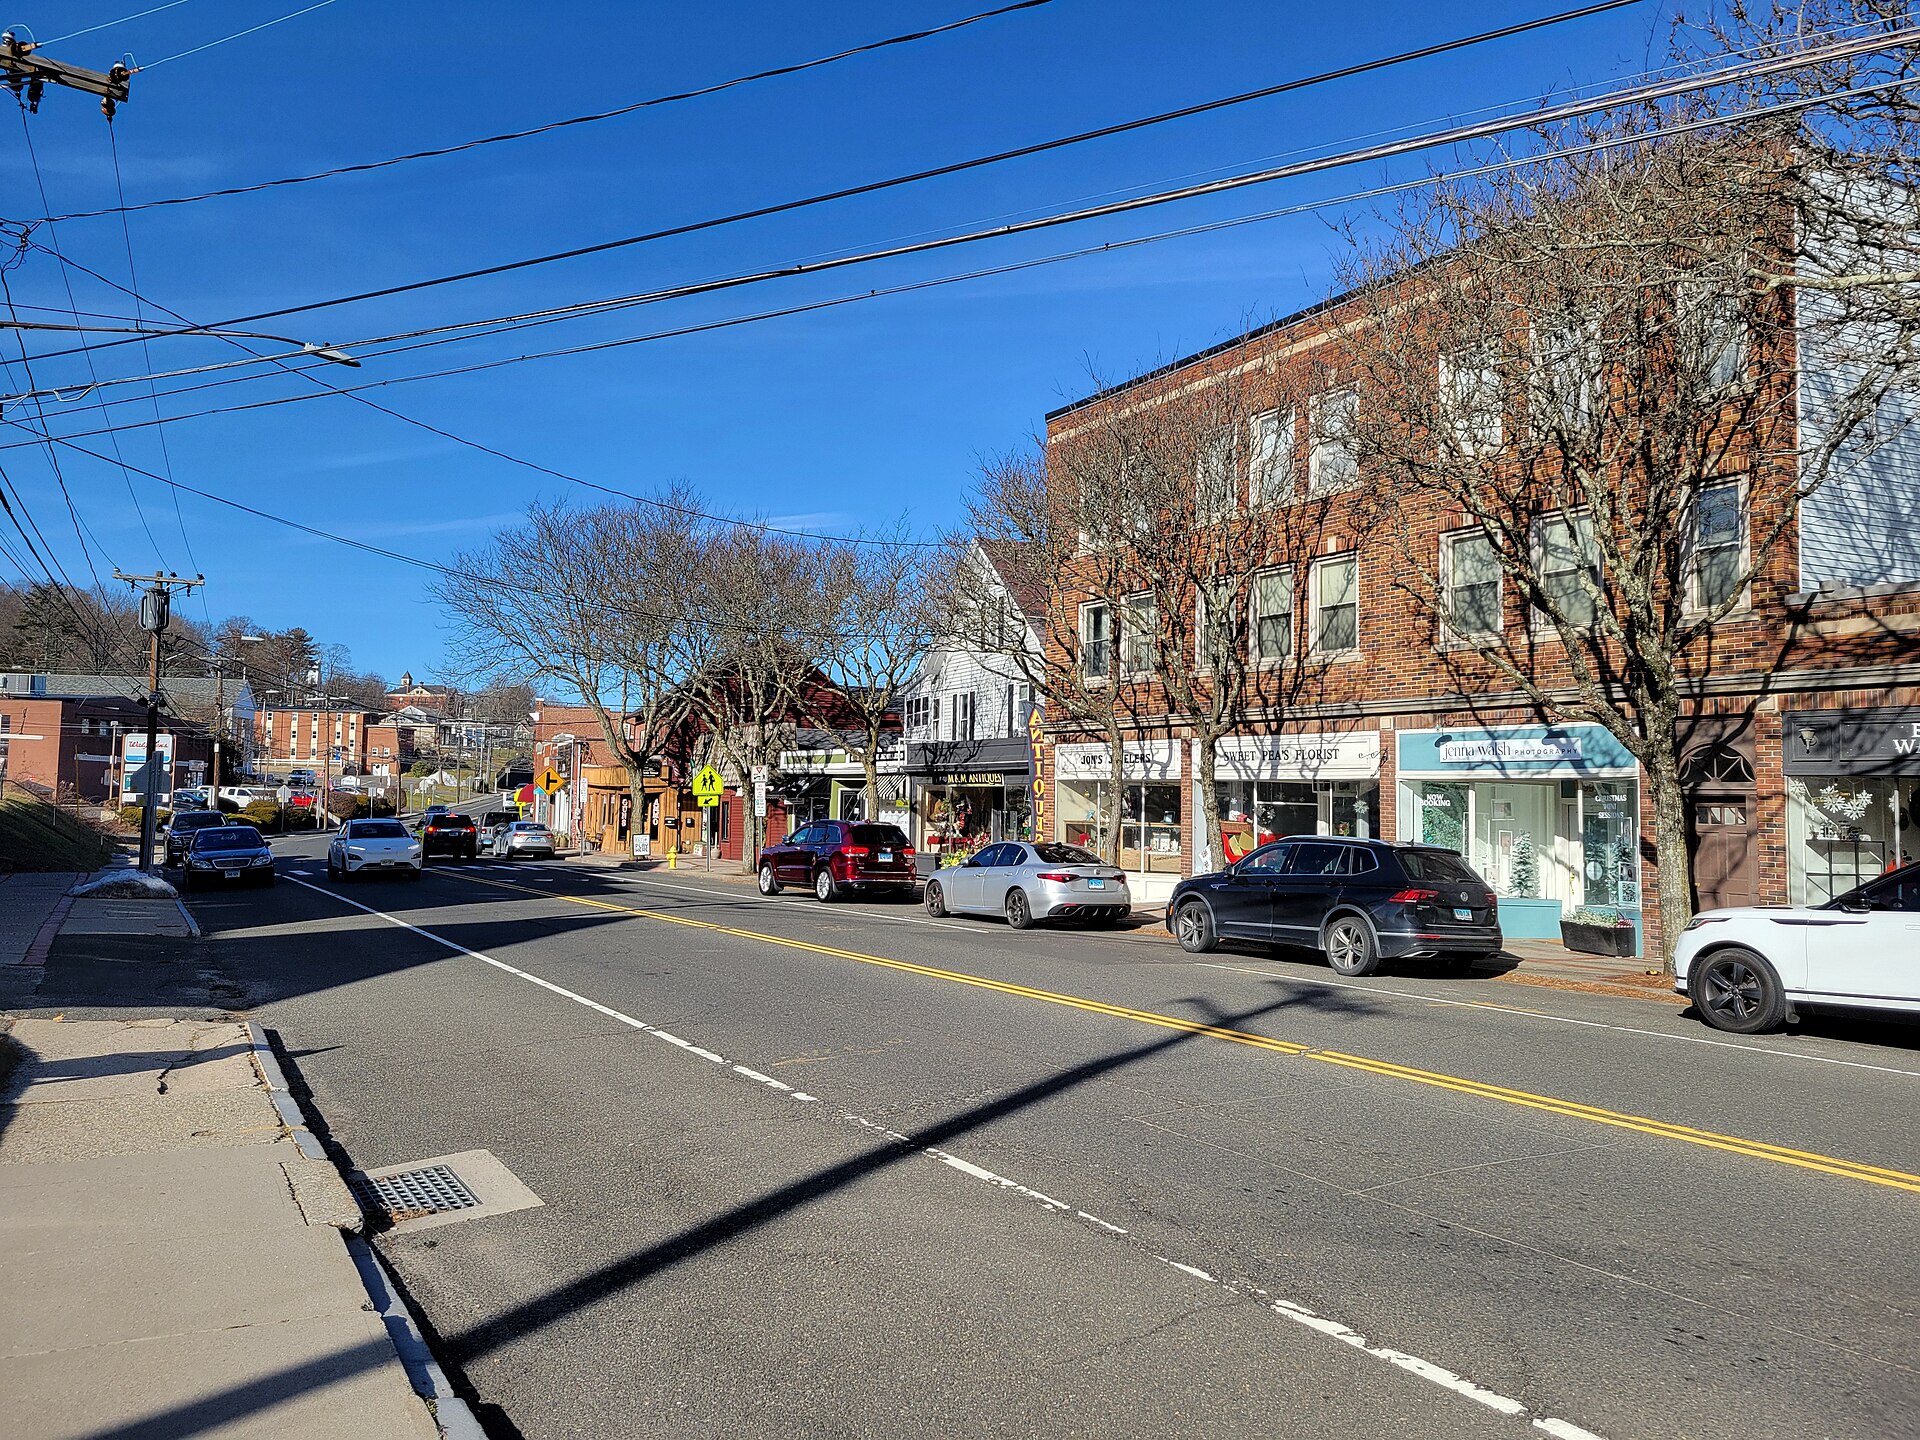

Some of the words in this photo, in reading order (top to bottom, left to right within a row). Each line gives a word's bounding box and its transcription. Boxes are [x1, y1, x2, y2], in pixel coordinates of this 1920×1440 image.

[1223, 751, 1256, 761] SWEET
[1262, 749, 1290, 761] PEA'S
[1295, 748, 1340, 760] FLORIST
[1442, 744, 1475, 760] jenna
[1477, 741, 1511, 757] walsh
[1514, 747, 1578, 755] PHOTOGRAPHY
[1081, 754, 1103, 765] JON'S
[1108, 753, 1151, 765] JELERS
[968, 773, 1002, 785] ANTIQUES
[1426, 793, 1445, 801] NOW
[1594, 794, 1628, 802] CHRISTMAS
[1420, 799, 1451, 807] BOOKING
[1598, 811, 1625, 819] SESSIONS
